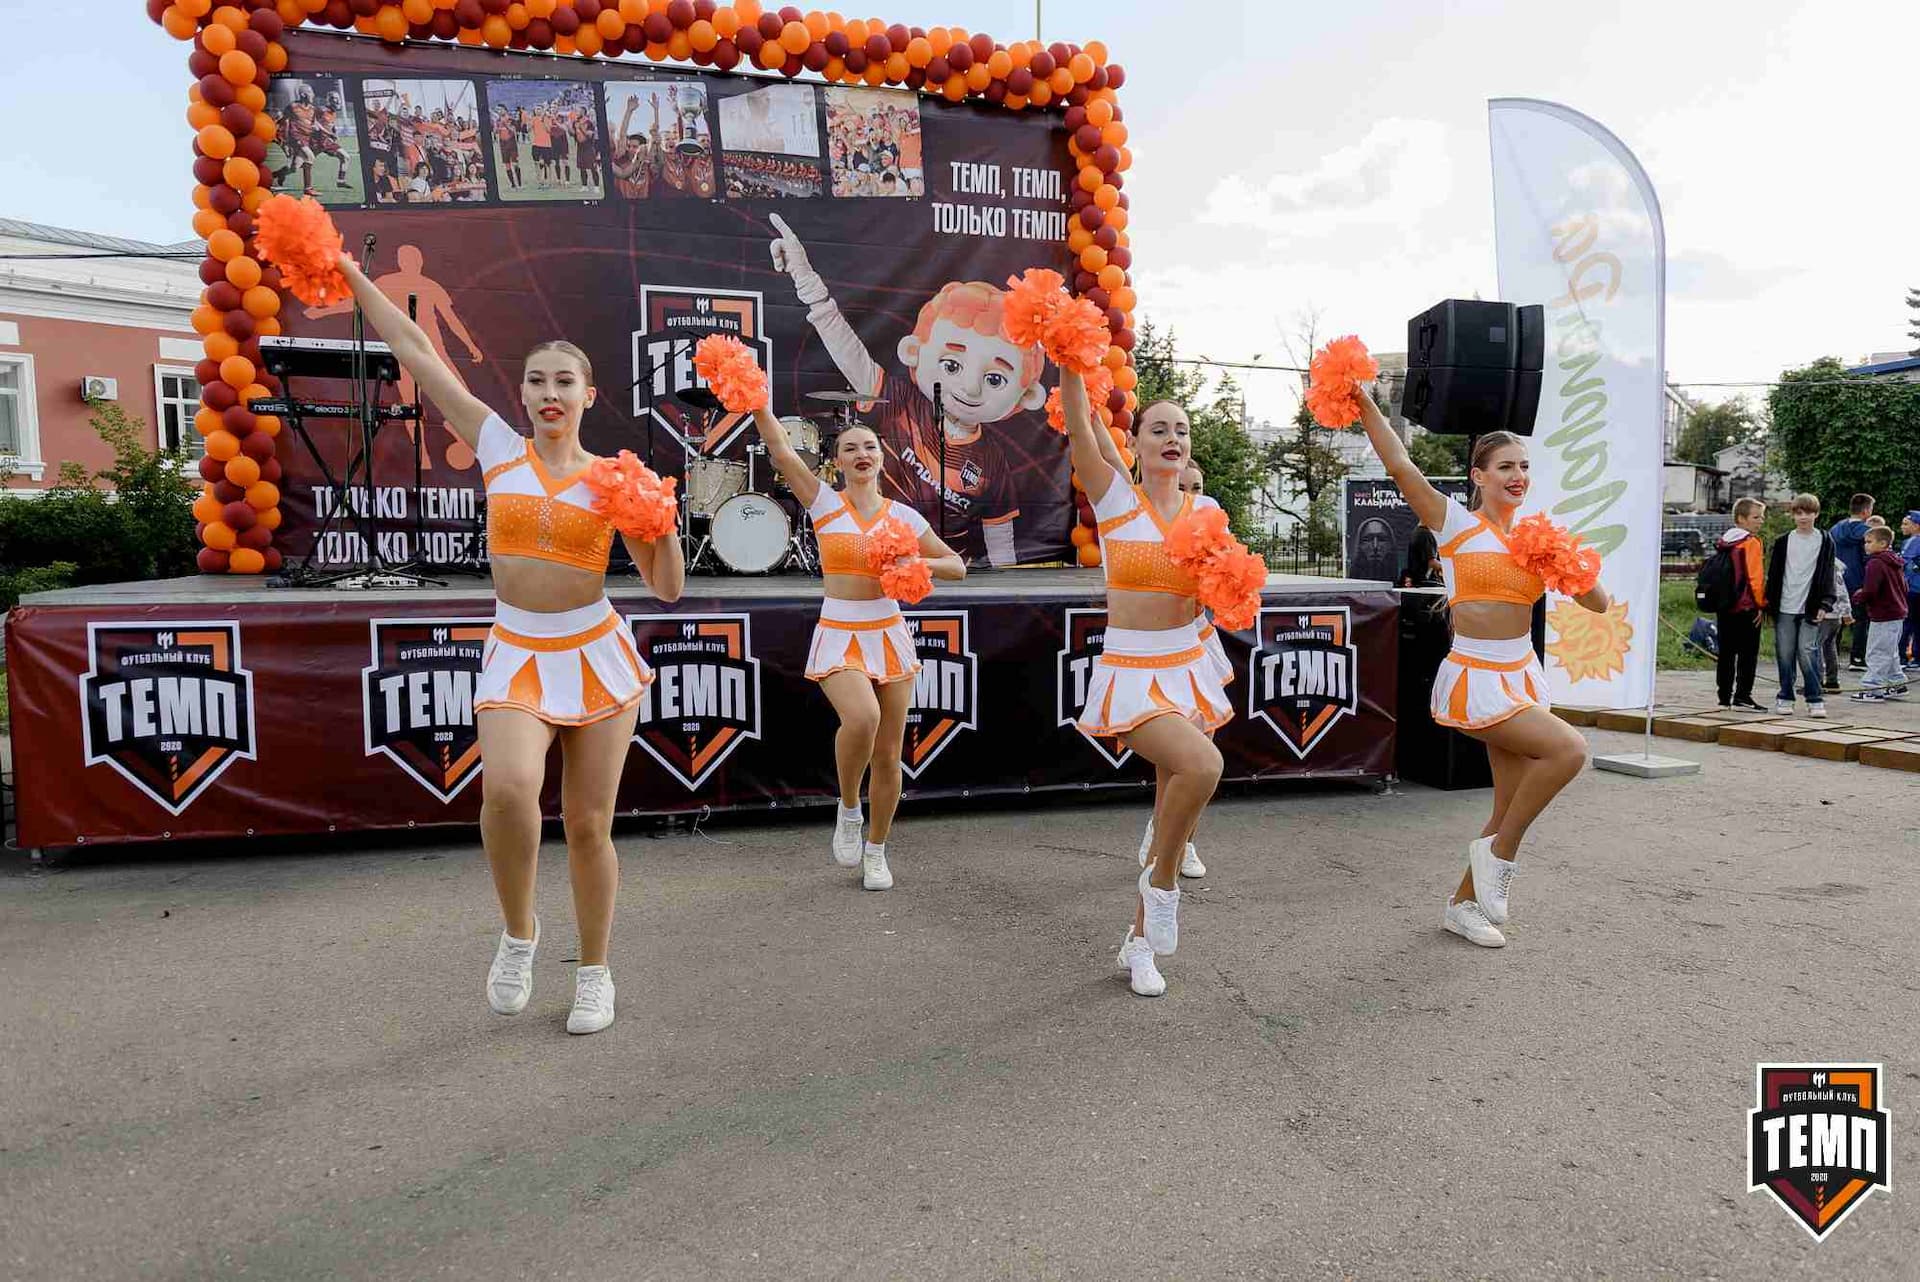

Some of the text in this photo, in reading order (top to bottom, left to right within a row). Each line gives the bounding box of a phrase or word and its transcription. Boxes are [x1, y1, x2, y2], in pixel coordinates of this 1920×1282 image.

[950, 161, 1066, 203] ТЕМП, ТЕМП,
[931, 202, 1066, 240] ТОЛЬКО ТЕМП!
[667, 315, 739, 330] ФУТБОЛЬНЫЙ КЛУБ
[121, 651, 211, 666] ФУТБОЛЬНЫЙ КЛУБ
[400, 646, 481, 660] ФУТБОЛЬНЫЙ КЛУБ
[653, 640, 726, 654] ФУТБОЛЬНЫЙ КЛУБ
[640, 664, 746, 724] ТЕМП
[911, 659, 964, 713] МП
[1262, 650, 1347, 701] ТЕМП
[100, 677, 238, 742] ТЕМП
[379, 670, 482, 734] ТЕМ
[160, 741, 182, 751] 2020
